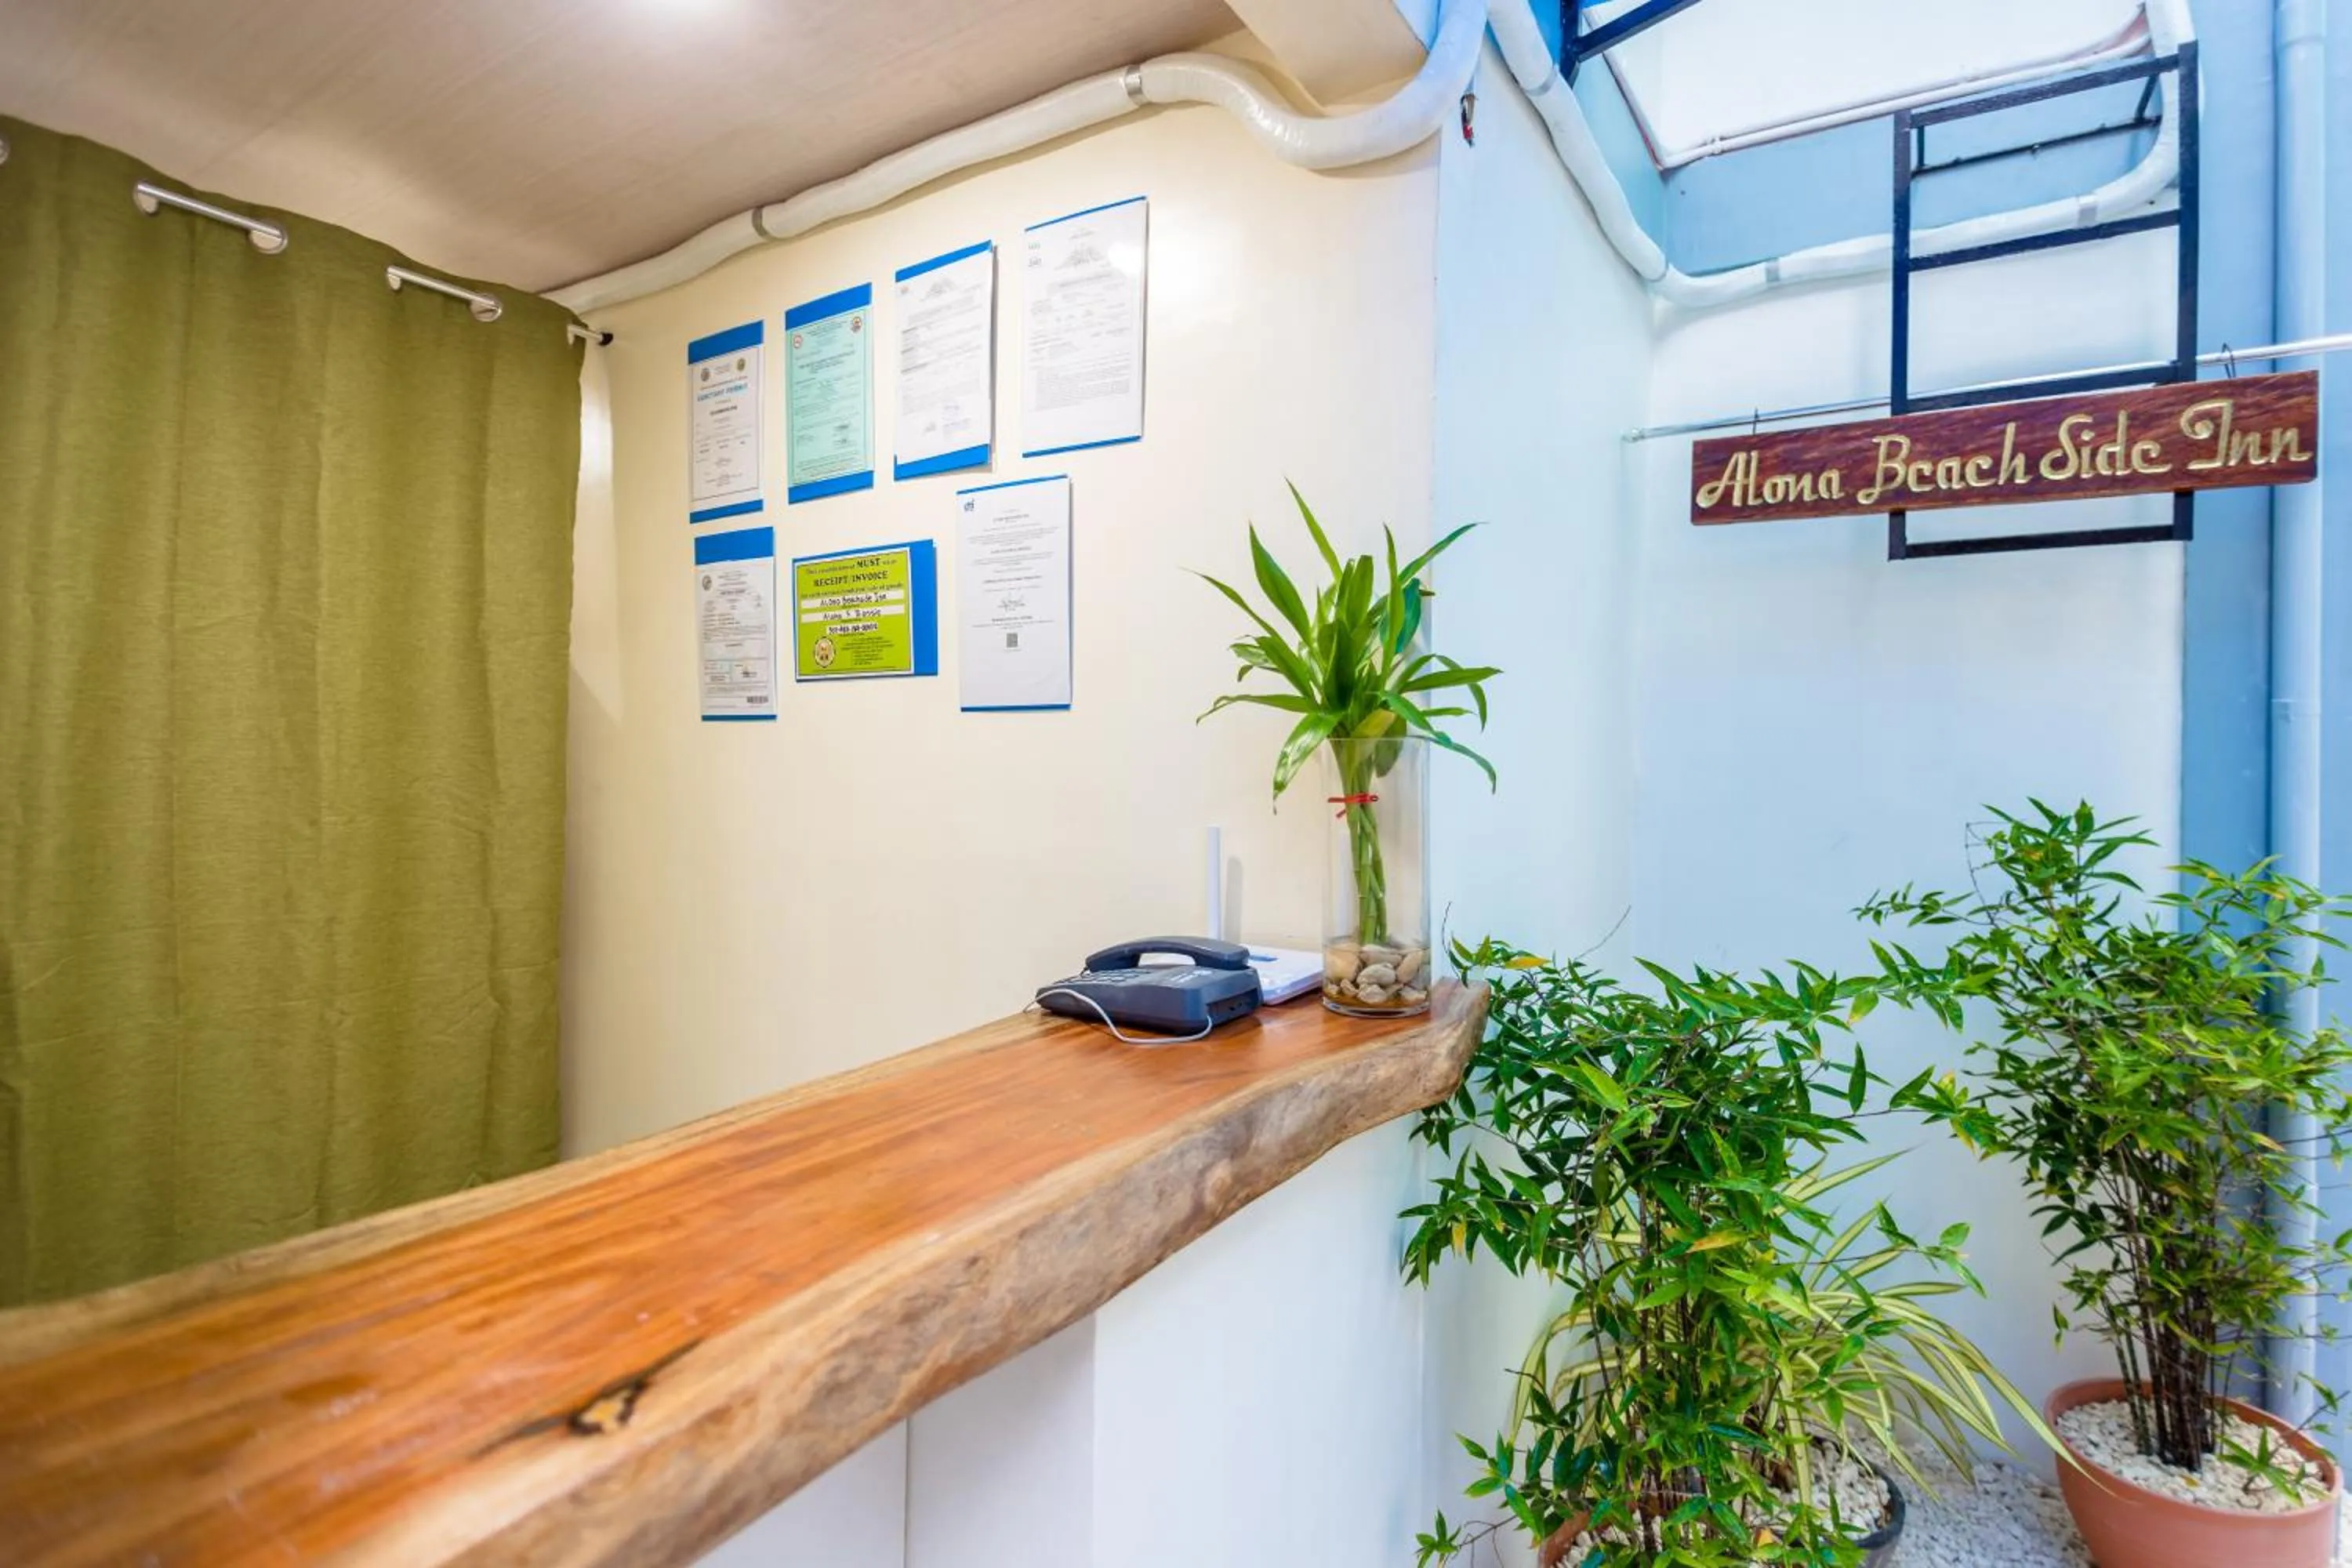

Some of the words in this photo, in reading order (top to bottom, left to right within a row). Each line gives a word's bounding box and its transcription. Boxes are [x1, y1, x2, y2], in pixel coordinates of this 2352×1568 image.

[1696, 450, 1846, 509] Alona
[1857, 422, 2033, 505] Beach
[2040, 409, 2172, 481] Side
[2180, 398, 2314, 470] Inn
[857, 557, 880, 568] MUST
